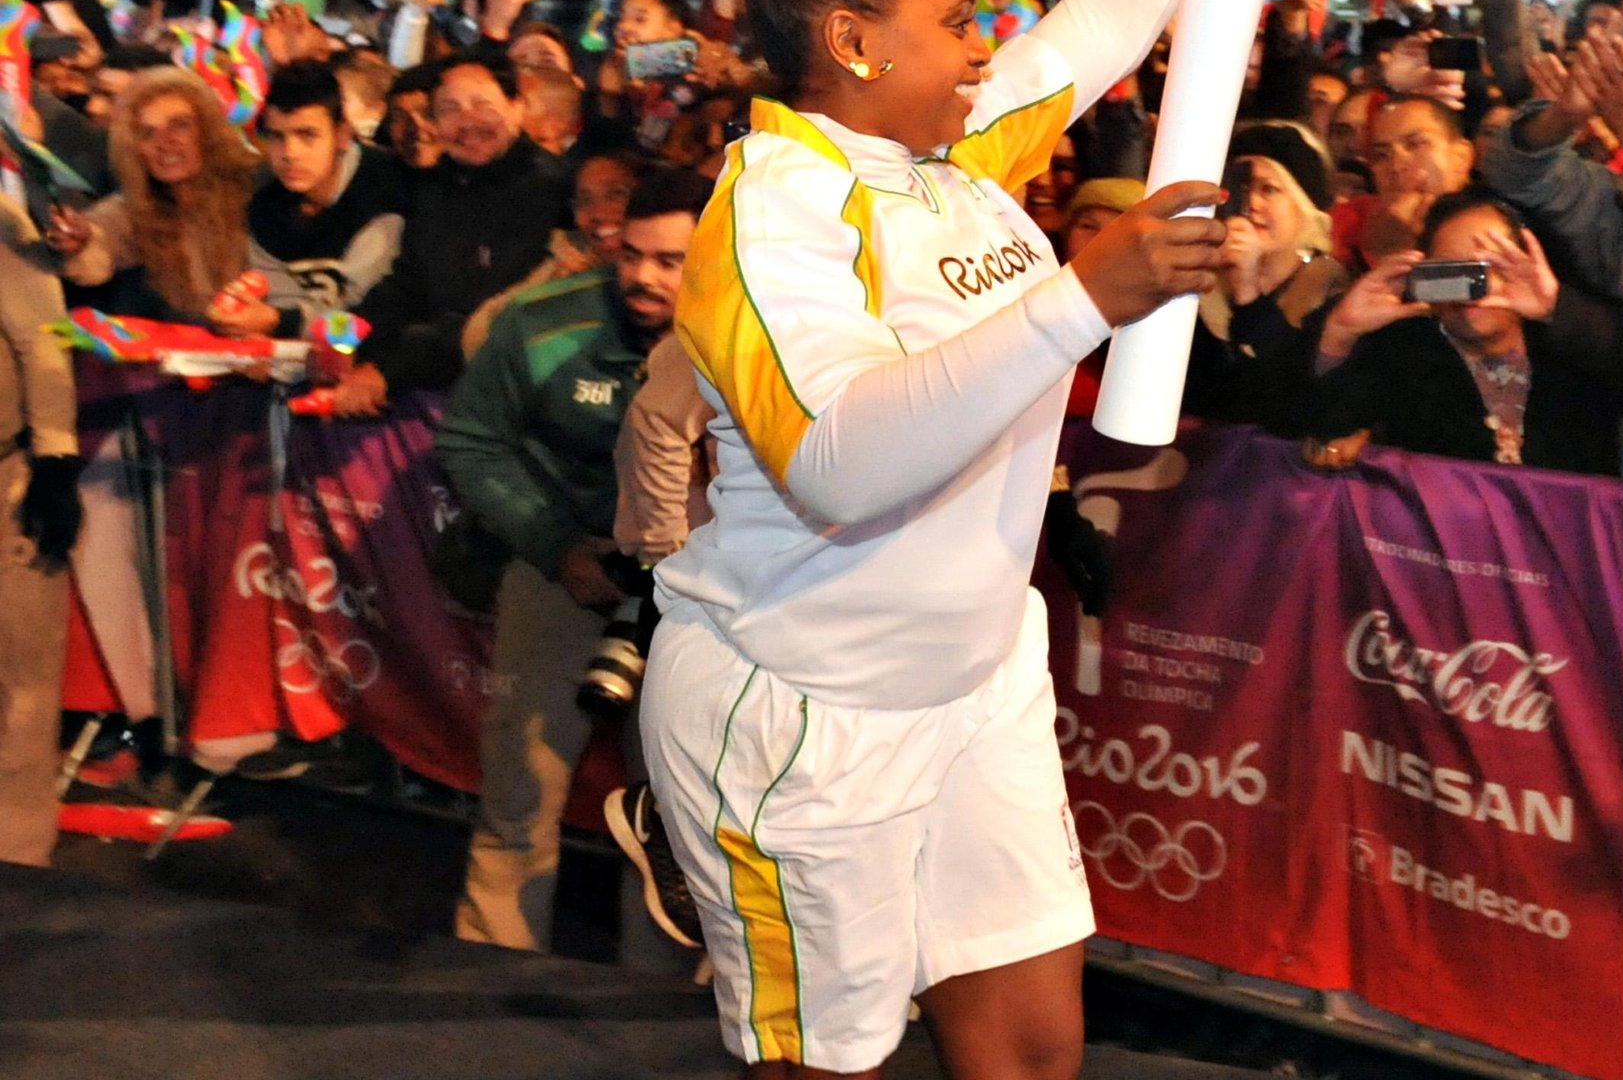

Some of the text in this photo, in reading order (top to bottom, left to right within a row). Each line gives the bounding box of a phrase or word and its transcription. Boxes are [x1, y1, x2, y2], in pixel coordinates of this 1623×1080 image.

[1125, 622, 1264, 665] REVEZAMENTO
[1346, 610, 1569, 733] Coca-Cola
[1054, 706, 1267, 806] Rio2016
[1340, 730, 1575, 843] NISSAN
[1389, 844, 1571, 940] Bradesco
